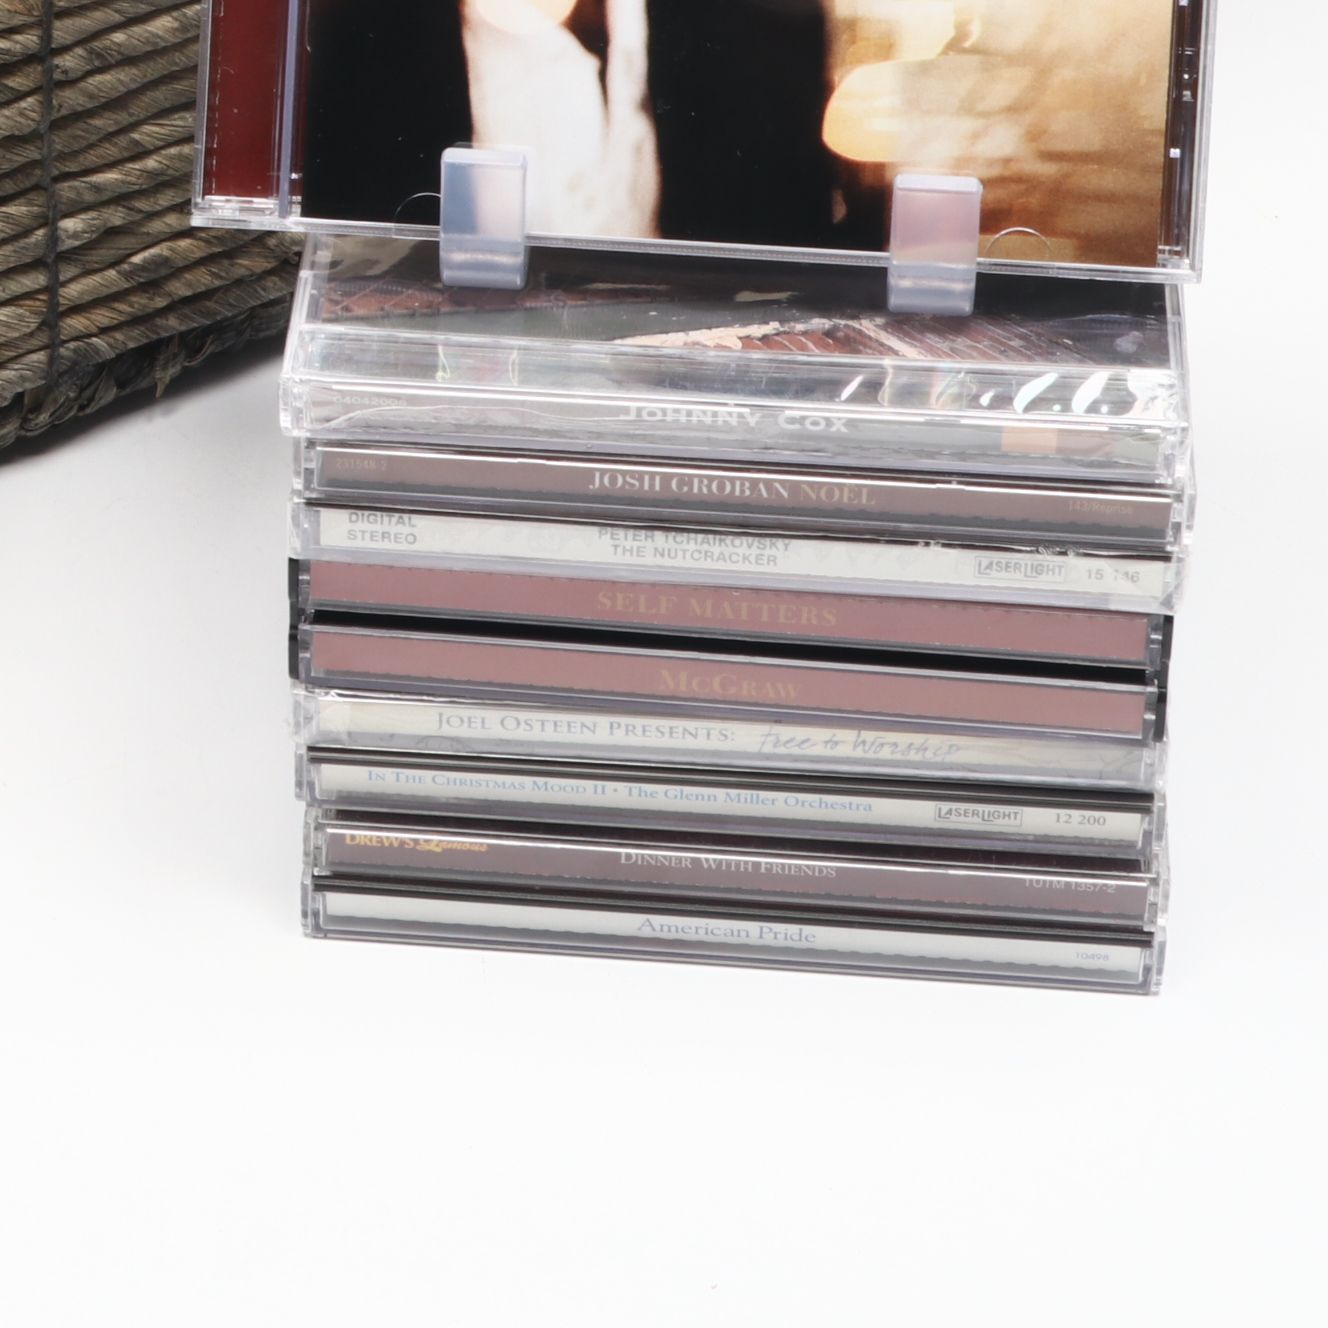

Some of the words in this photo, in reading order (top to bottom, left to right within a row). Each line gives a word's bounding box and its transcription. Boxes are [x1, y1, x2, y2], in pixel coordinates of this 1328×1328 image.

[589, 471, 661, 492] JOSH
[672, 476, 791, 500] GROBAN
[800, 482, 877, 506] NOËL
[348, 511, 418, 529] DIGITAL
[347, 529, 418, 546] STEREO
[598, 527, 656, 544] PETER
[663, 532, 792, 552] TCHAIKOVSKY
[612, 544, 647, 559] THE
[653, 546, 779, 567] NUTCRACKER
[1087, 568, 1105, 581] 15
[598, 591, 677, 615] SELF
[688, 597, 838, 626] MATTERS
[500, 715, 598, 736] OSTEEN
[591, 781, 607, 796] II
[622, 784, 658, 799] The
[664, 786, 719, 803] Glenn
[723, 789, 778, 807] Miller
[784, 794, 872, 812] Orchestra
[1055, 812, 1072, 825] 12
[1077, 814, 1107, 827] 200
[637, 917, 750, 940] American
[757, 925, 817, 944] Pride
